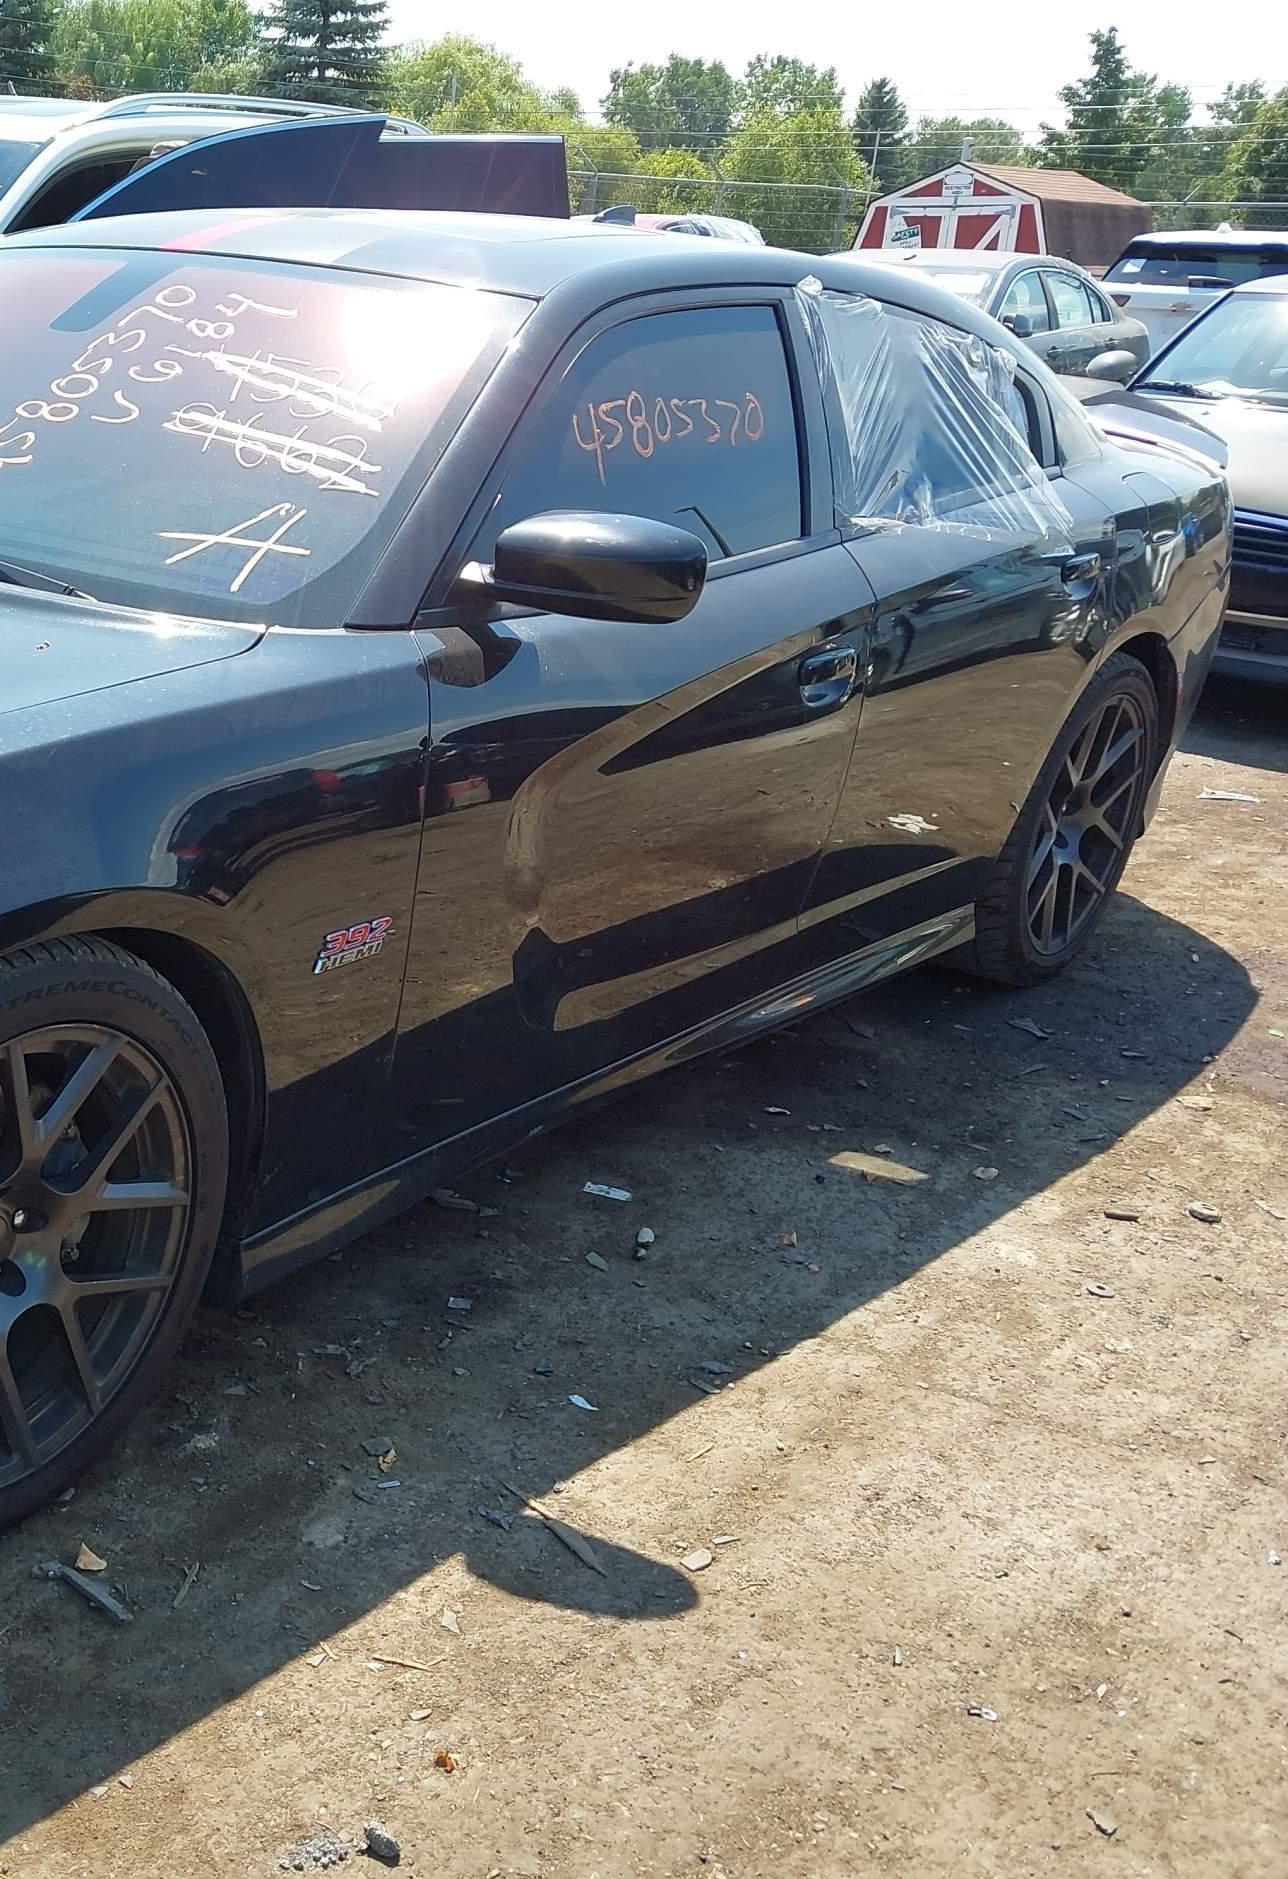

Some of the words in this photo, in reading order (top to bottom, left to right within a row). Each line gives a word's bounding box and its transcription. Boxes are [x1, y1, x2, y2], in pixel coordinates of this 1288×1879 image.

[572, 390, 763, 487] 45805370
[313, 939, 383, 975] HEMI
[319, 916, 393, 958] 392
